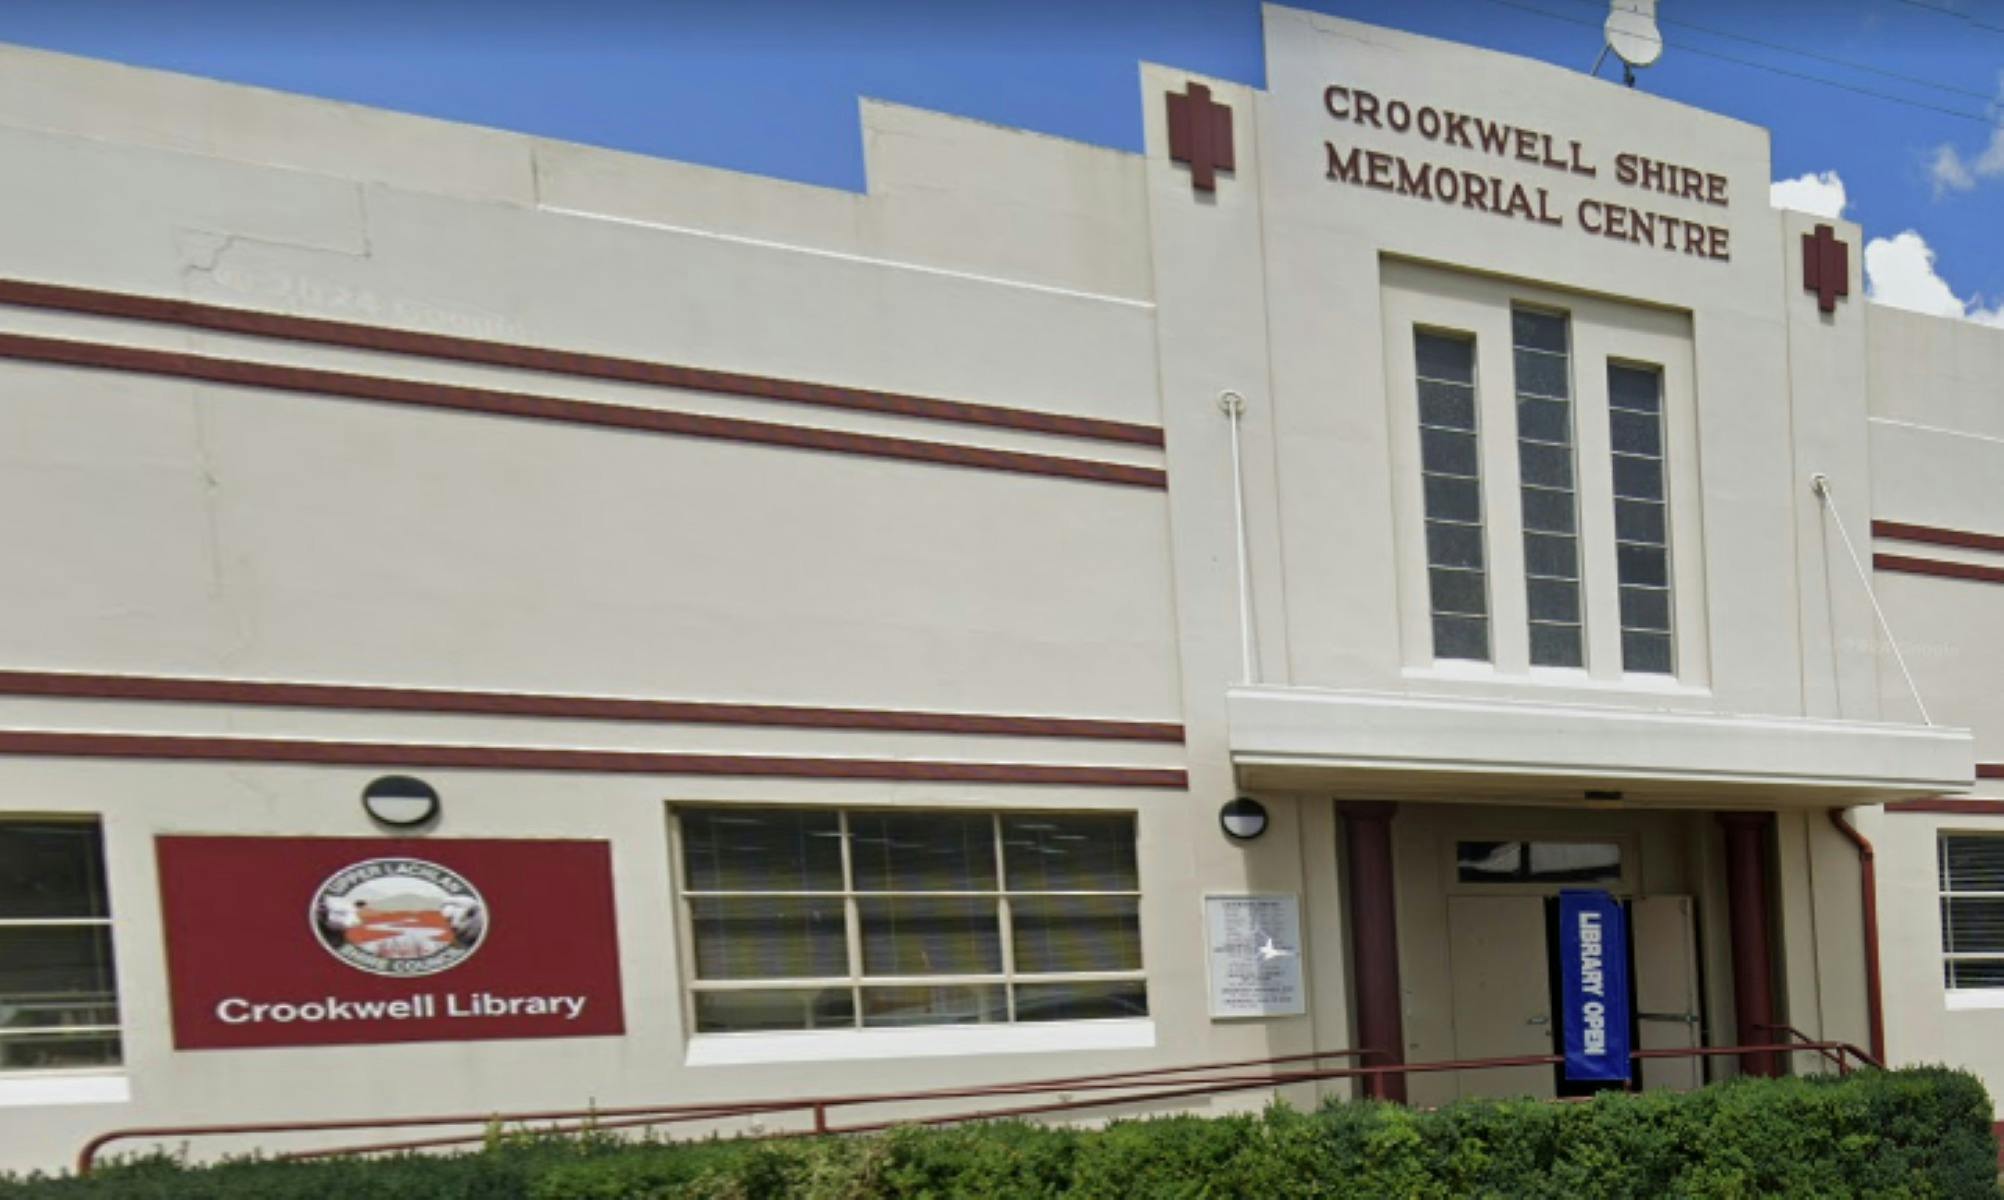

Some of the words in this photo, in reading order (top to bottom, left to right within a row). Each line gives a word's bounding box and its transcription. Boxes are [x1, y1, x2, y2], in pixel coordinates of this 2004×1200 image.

[1323, 85, 1597, 176] CROOKWELL
[1615, 153, 1730, 206] SHIRE
[1323, 142, 1563, 227] MEMORIAL
[1577, 199, 1731, 261] CENTRE
[1578, 911, 1605, 997] LIBRARY
[215, 994, 434, 1024] Crookwell
[447, 993, 587, 1019] Library
[1582, 1001, 1606, 1056] OPEN
